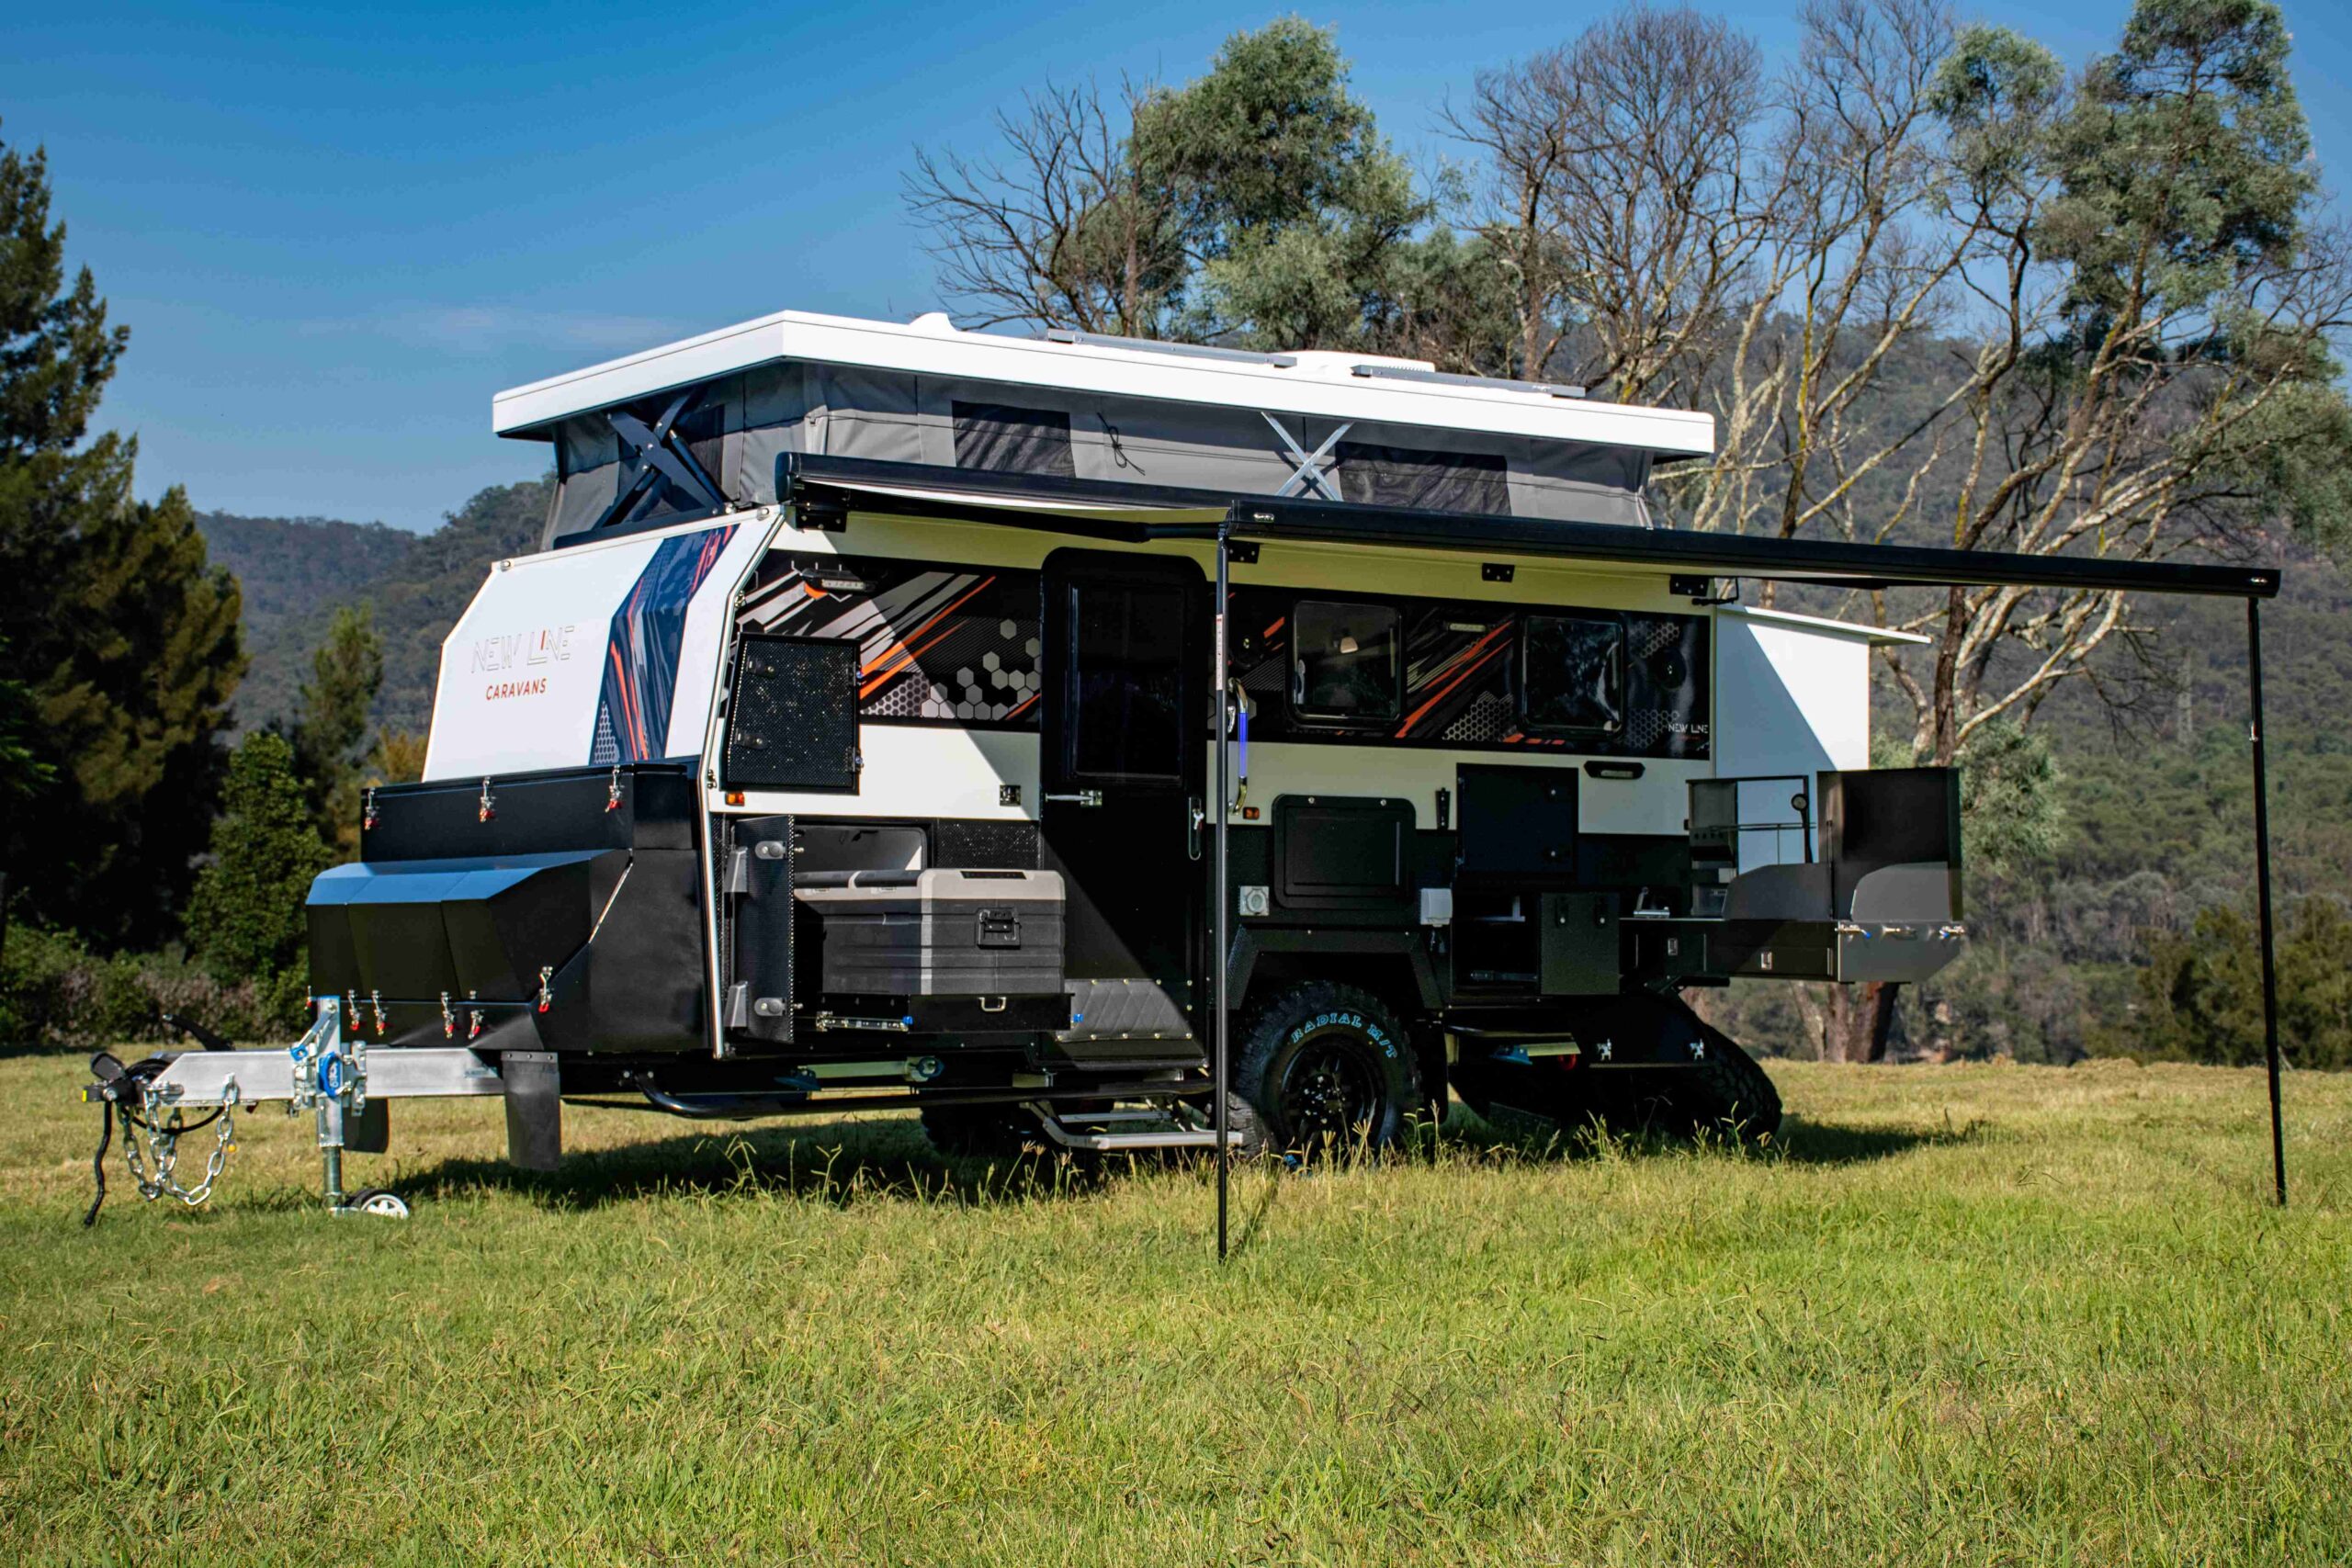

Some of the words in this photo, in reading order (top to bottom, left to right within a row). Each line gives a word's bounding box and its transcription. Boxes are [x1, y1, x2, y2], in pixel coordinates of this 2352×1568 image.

[471, 633, 522, 673] NEW
[526, 626, 575, 666] LINE
[485, 677, 548, 701] CARAVANS
[1668, 723, 1688, 733] NEW
[1290, 1012, 1363, 1044] RADIAL
[1367, 1023, 1398, 1059] M/T
